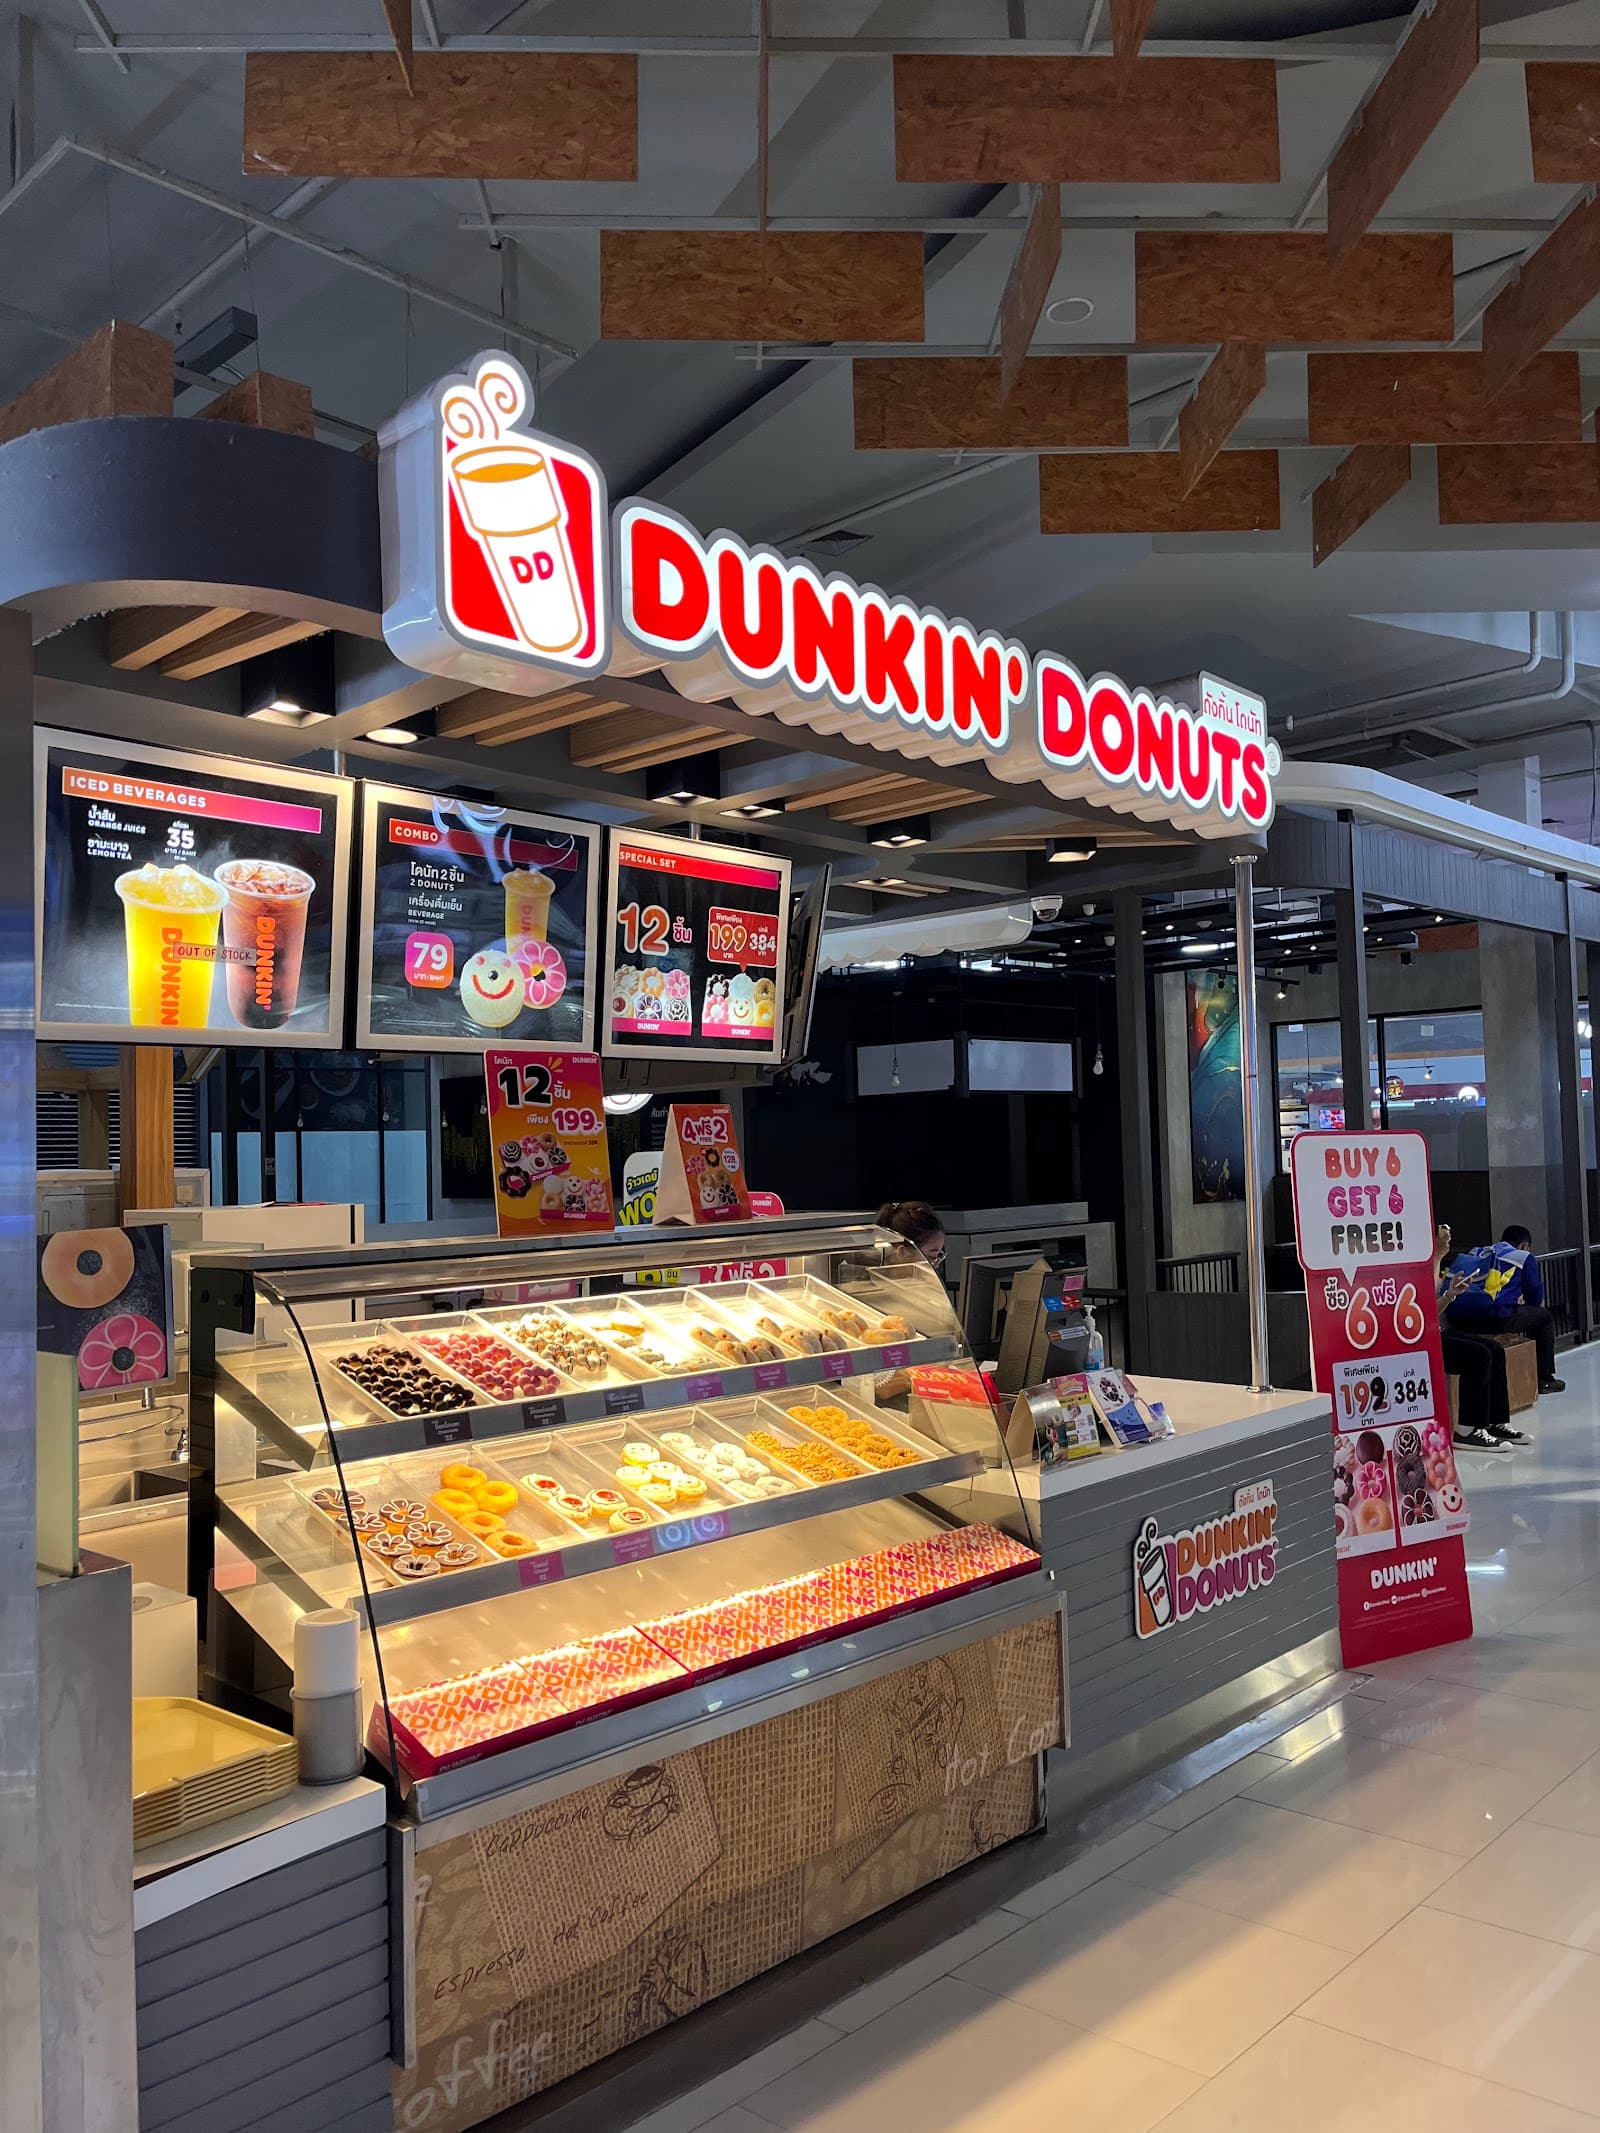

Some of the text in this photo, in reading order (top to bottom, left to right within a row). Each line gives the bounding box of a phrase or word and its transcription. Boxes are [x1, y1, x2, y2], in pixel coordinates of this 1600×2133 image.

[509, 551, 554, 584] DD
[631, 518, 1267, 820] DUNKIN' DONUTS
[70, 775, 207, 808] ICED BEVERAGES
[88, 819, 146, 834] ORANGE JUICE
[166, 828, 194, 849] 35
[395, 826, 439, 842] COMBO
[87, 848, 132, 861] LEMON TEA
[619, 851, 676, 869] SPECIAL SET
[410, 878, 455, 891] 2 DONUTS
[440, 869, 448, 881] 2
[408, 909, 445, 920] BEVERAGE
[618, 903, 692, 956] 12 ชิ้น
[710, 923, 777, 952] 199 384
[177, 946, 252, 961] OUT OF STOCK
[413, 942, 448, 970] 79
[498, 1065, 552, 1107] 12
[684, 1118, 696, 1141] 4
[713, 1118, 728, 1141] 2
[1324, 1146, 1402, 1179] BUY 6
[617, 1189, 657, 1226] WO
[1327, 1184, 1404, 1218] GET 6
[1331, 1222, 1404, 1256] FREE!
[1346, 1287, 1378, 1349] 6
[1372, 1278, 1397, 1306] ฟรี
[1394, 1283, 1424, 1344] 6
[1394, 1378, 1429, 1404] 384
[1177, 1504, 1277, 1576] DUNKIN'
[1178, 1545, 1275, 1615] DONUTS
[1370, 1556, 1438, 1589] DUNKIN'
